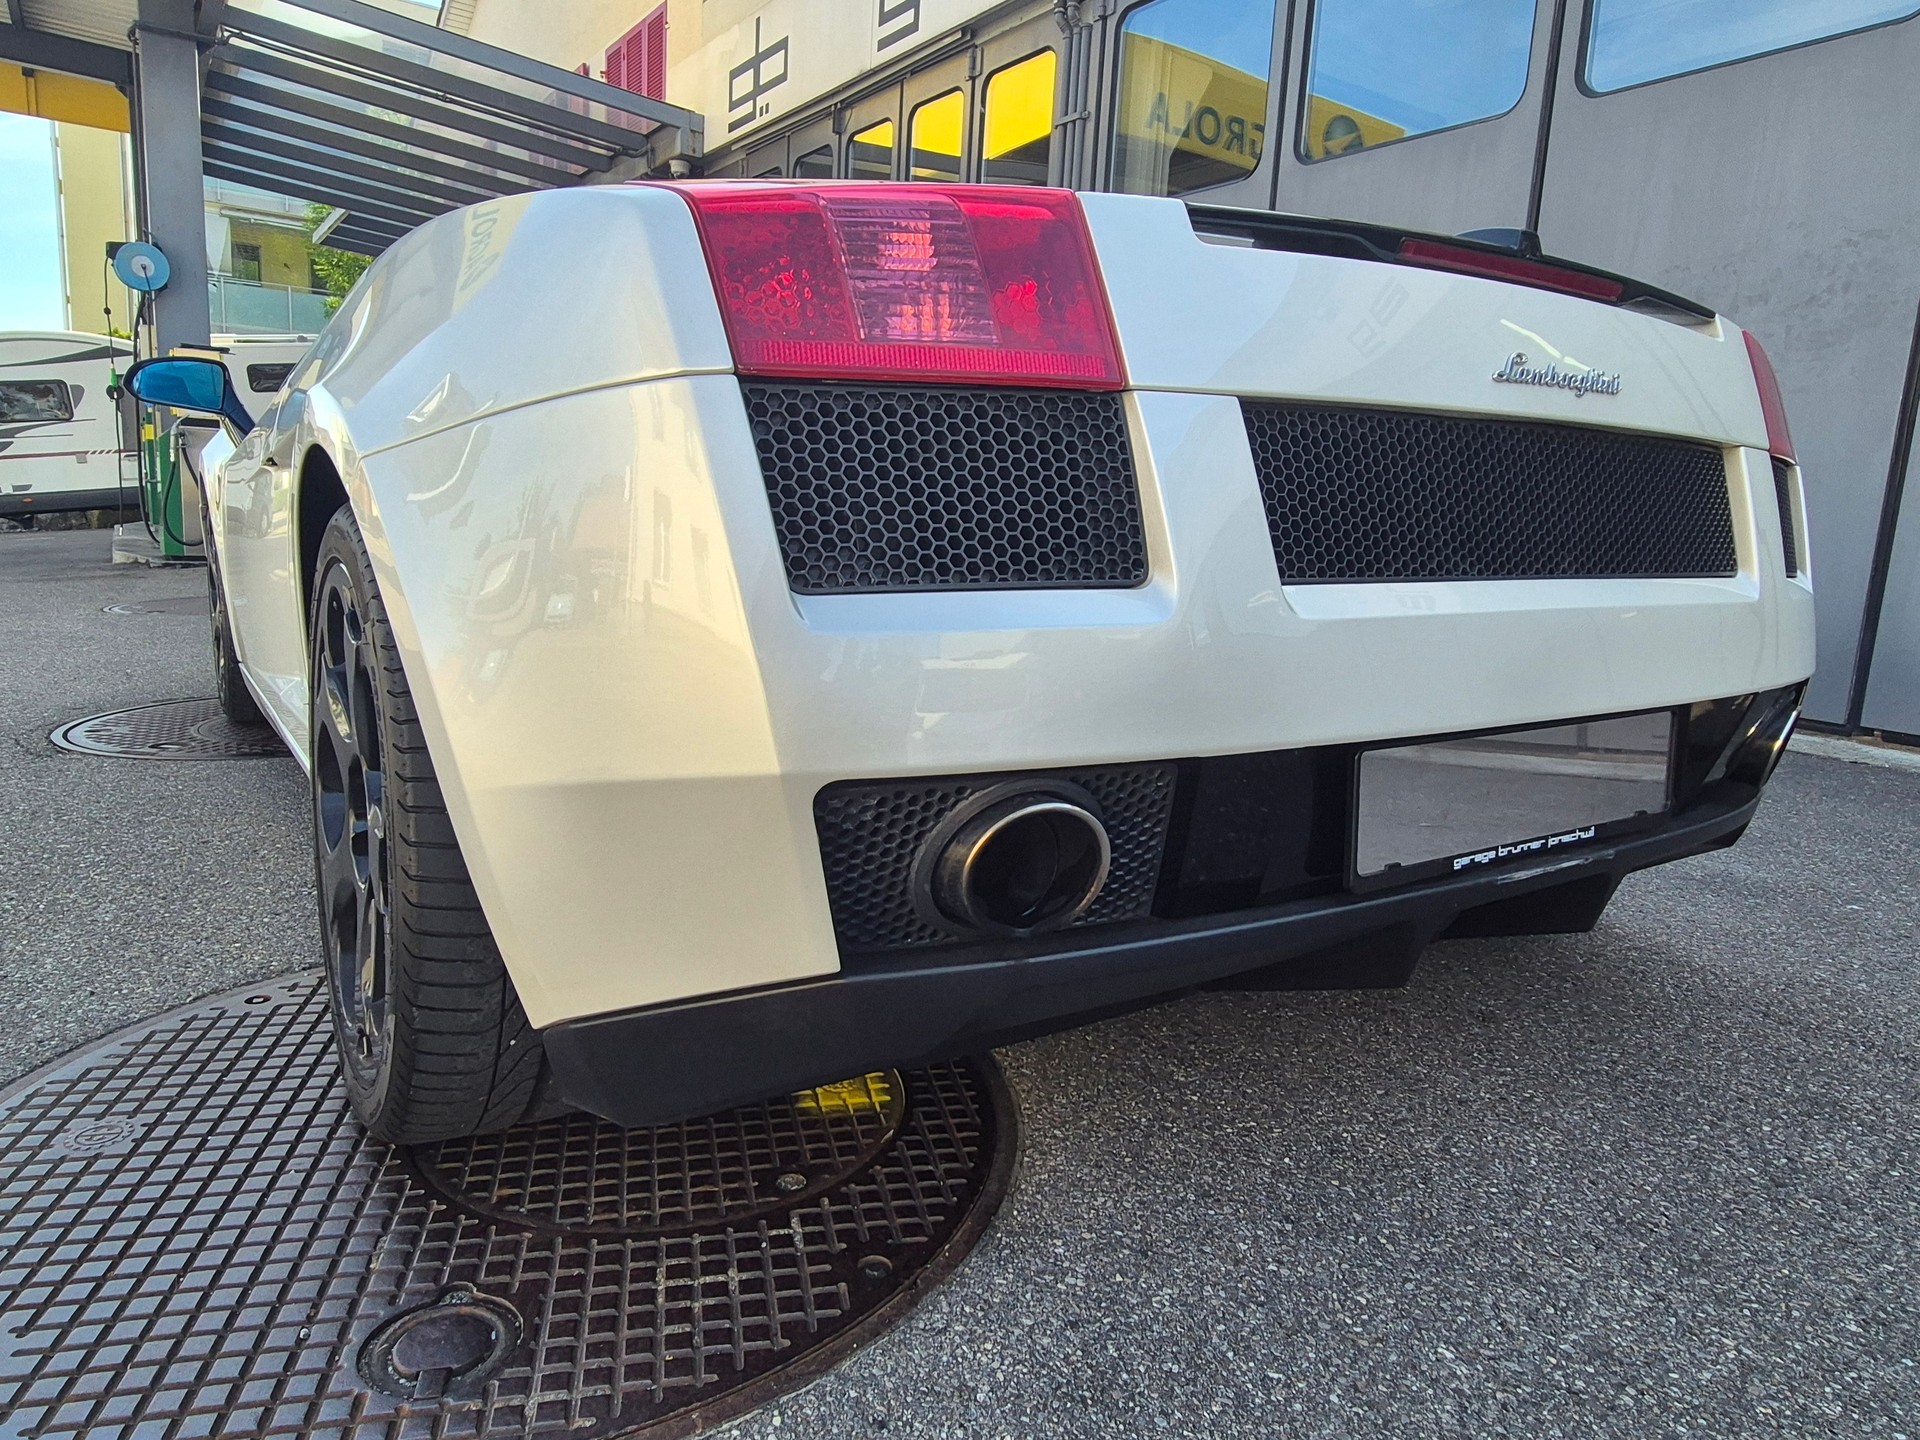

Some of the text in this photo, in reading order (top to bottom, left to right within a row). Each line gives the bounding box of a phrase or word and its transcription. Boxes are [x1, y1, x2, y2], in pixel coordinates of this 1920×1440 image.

[1492, 352, 1622, 398] Lamborghini
[1453, 850, 1496, 870] garage
[1498, 839, 1546, 857] brunner
